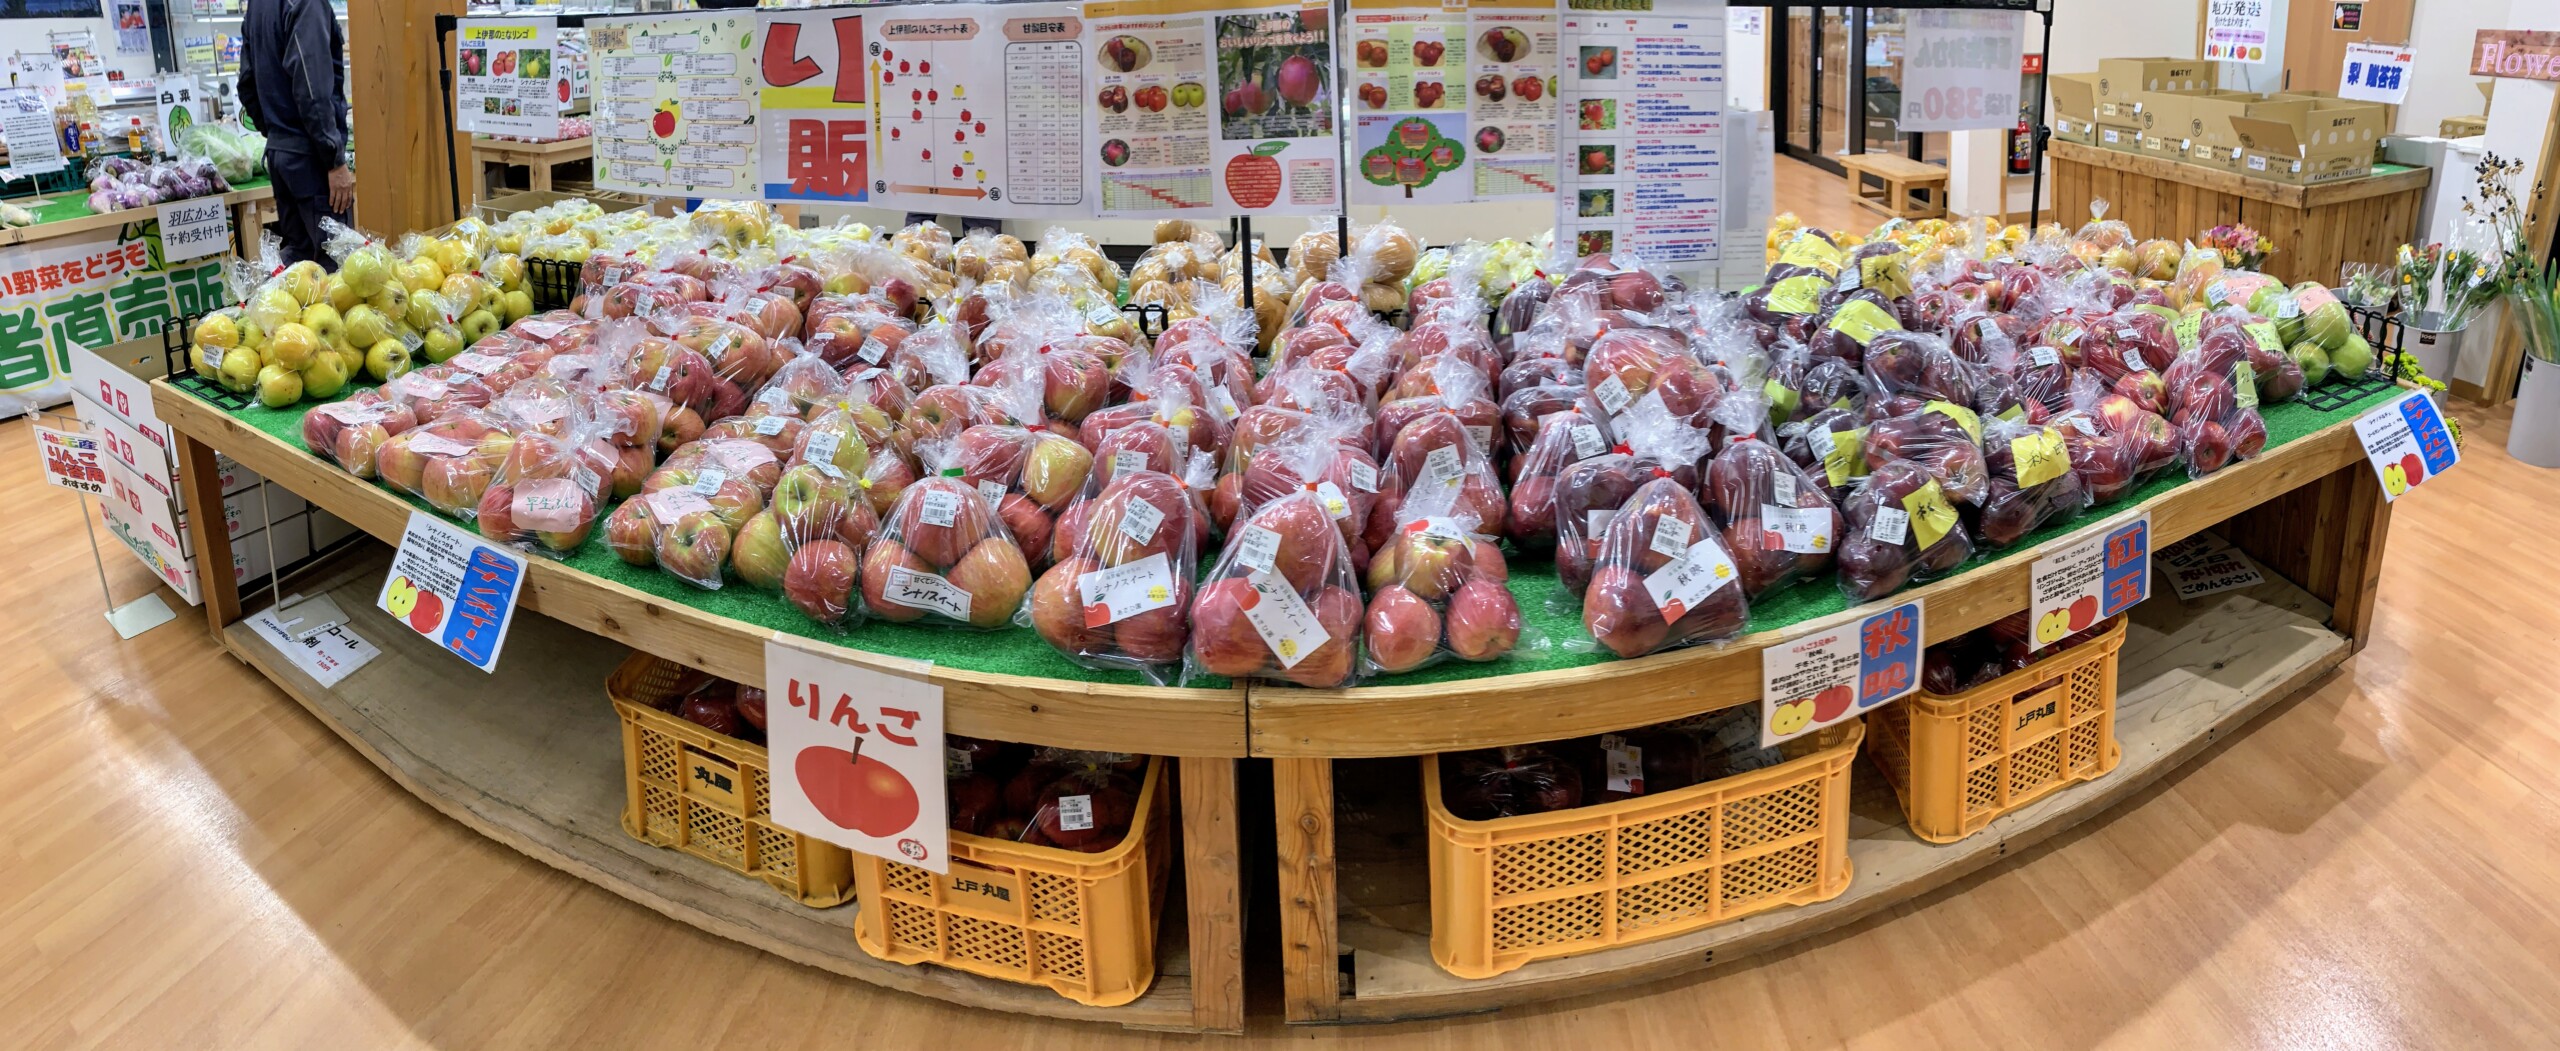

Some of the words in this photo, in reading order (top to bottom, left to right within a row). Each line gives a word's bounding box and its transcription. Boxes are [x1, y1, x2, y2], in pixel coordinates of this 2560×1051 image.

[2212, 0, 2261, 16] 地方発送
[557, 65, 571, 75] マト
[2347, 62, 2362, 85] 梨
[160, 88, 192, 104] 白菜
[168, 204, 219, 226] 羽広かぶ
[165, 223, 224, 246] 予約受付中
[47, 445, 98, 467] りんご
[61, 477, 102, 493] おすすめ
[1094, 571, 1154, 593] シナノスイート
[2107, 526, 2143, 615] 紅玉
[2182, 572, 2259, 594] ごめんなさい
[451, 551, 515, 660] シナノスイート
[902, 586, 961, 612] シナノスイート
[327, 627, 359, 650] ロール
[1863, 610, 1911, 699] 秋映
[787, 677, 922, 747] りんご
[2015, 701, 2057, 731] 上戸丸屋
[951, 877, 978, 892] 上戸
[981, 882, 1011, 902] 丸屋
